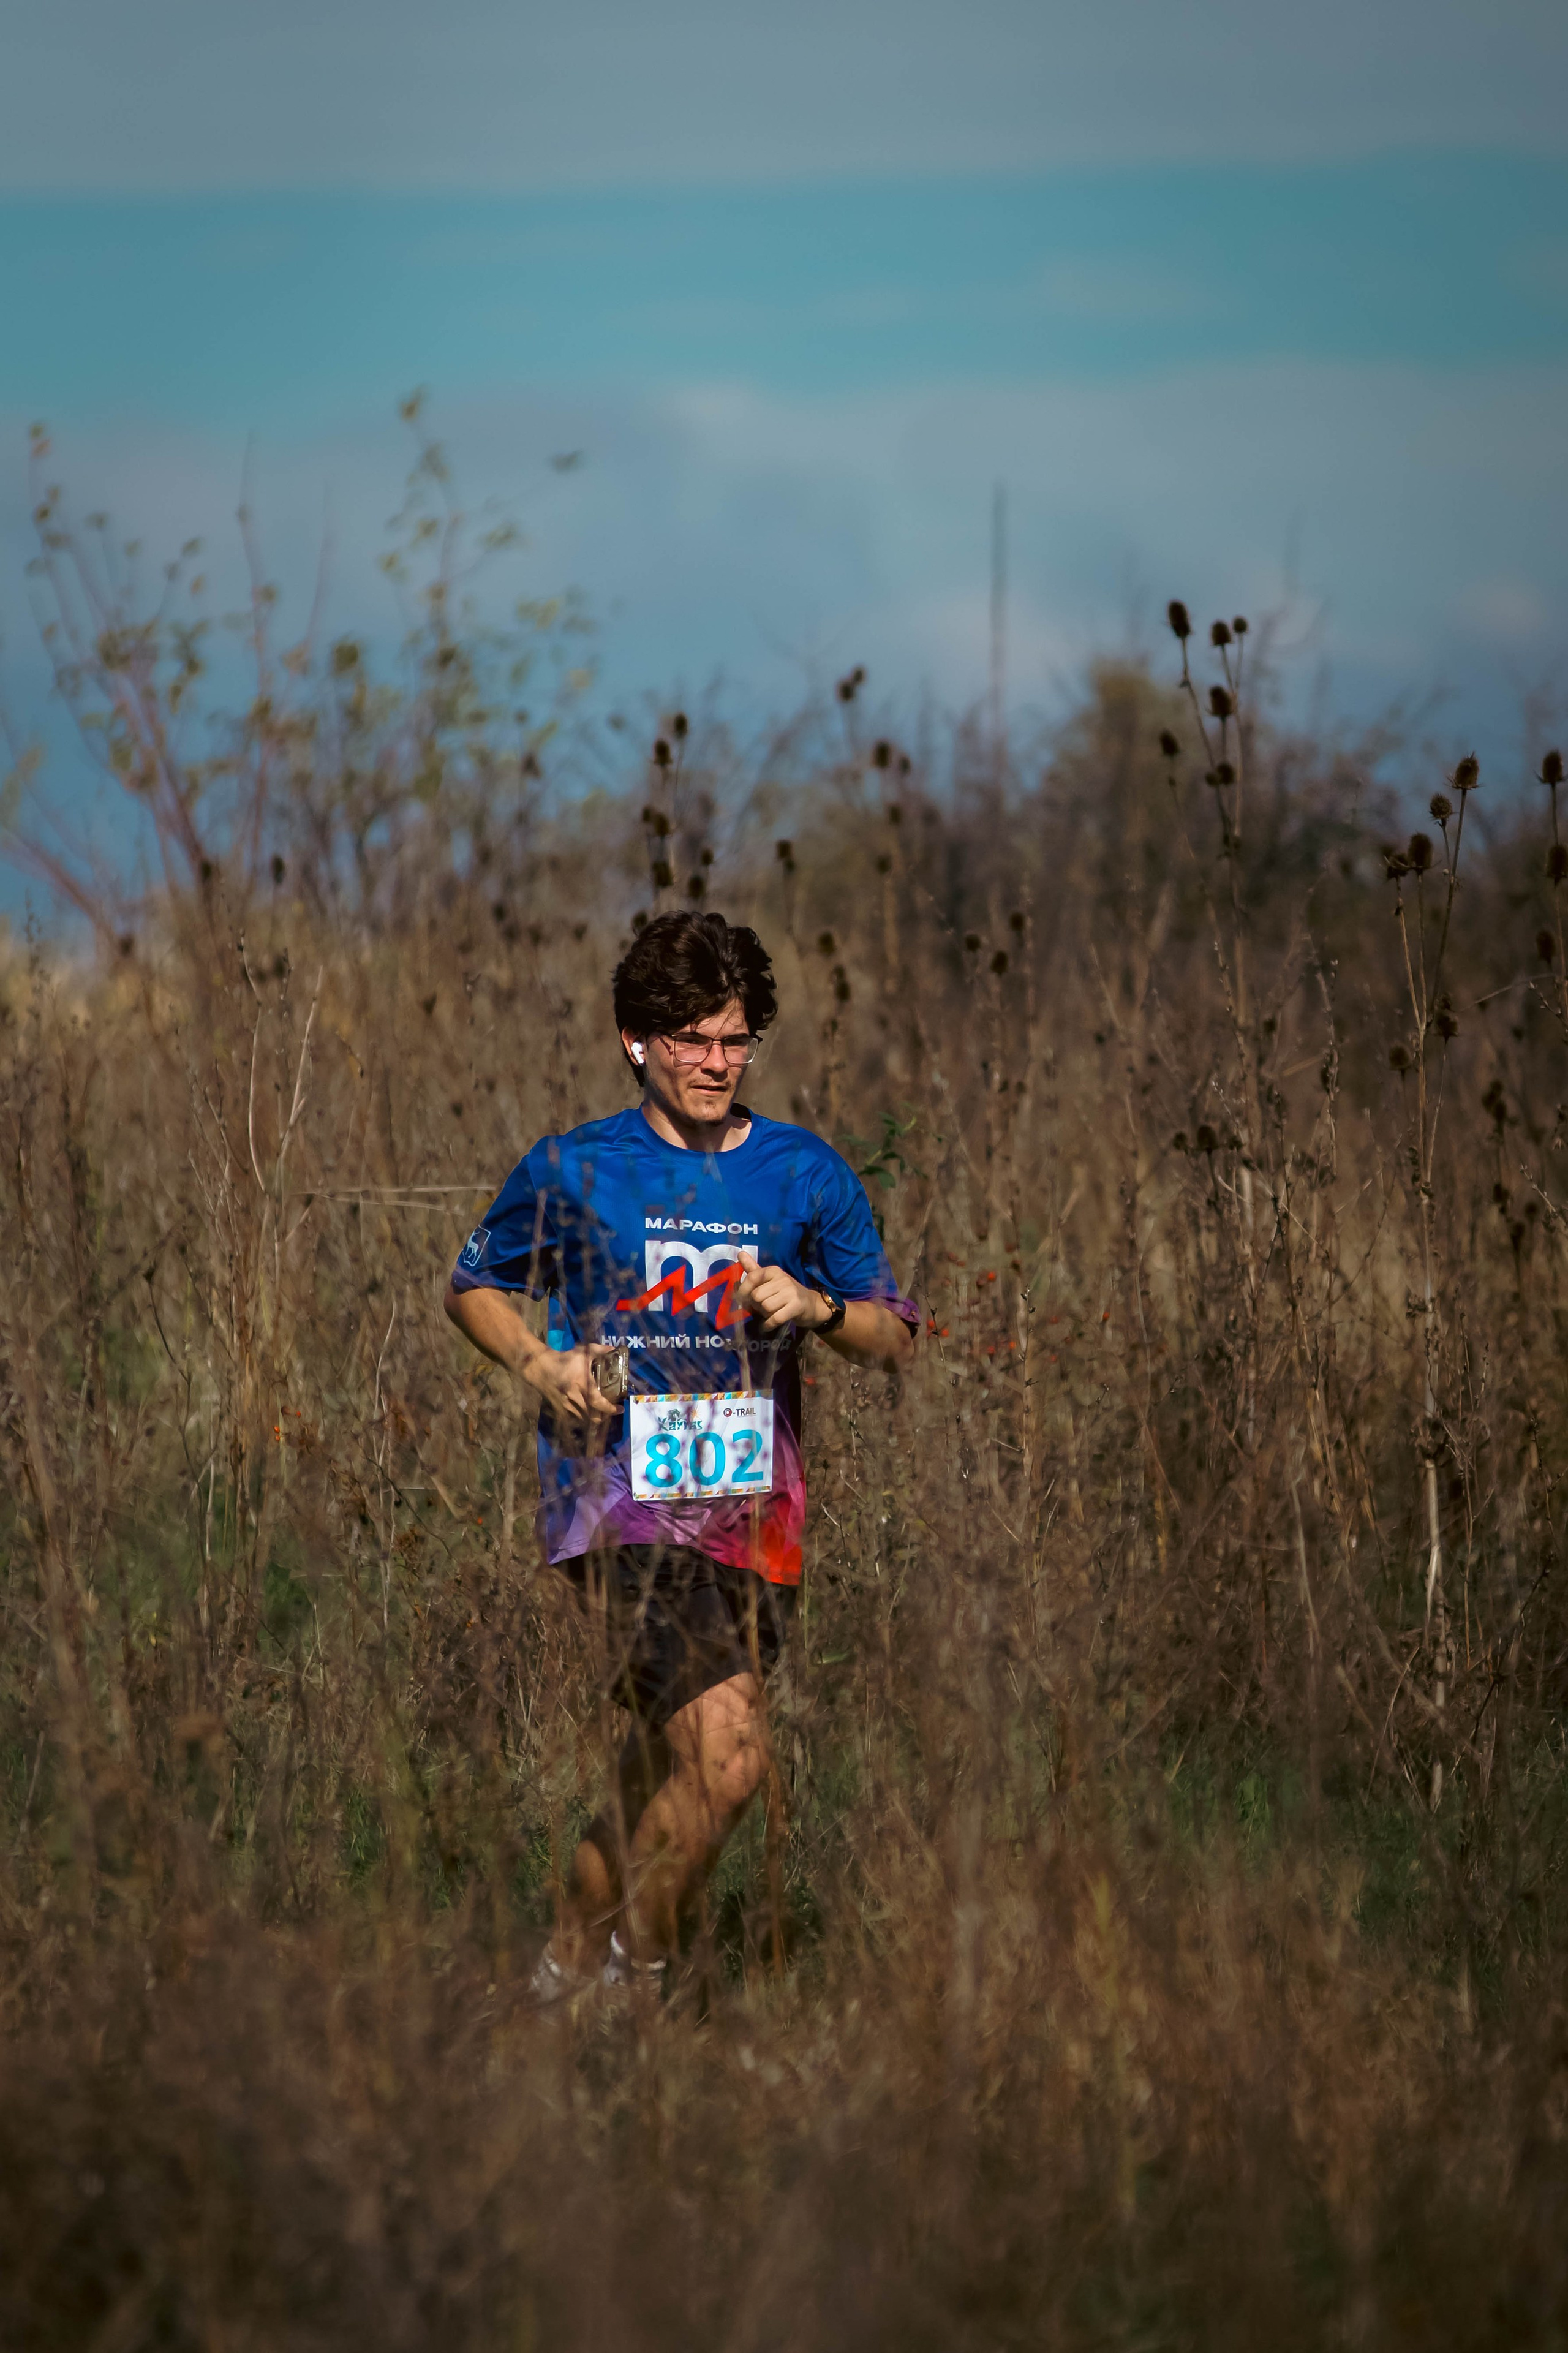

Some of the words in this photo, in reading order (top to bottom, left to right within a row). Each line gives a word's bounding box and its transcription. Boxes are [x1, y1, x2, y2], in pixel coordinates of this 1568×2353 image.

[645, 1217, 758, 1235] МАРАФОН
[601, 1333, 692, 1349] НИЖНИЙ
[696, 1335, 791, 1352] НООРОД
[645, 1429, 764, 1488] 802
